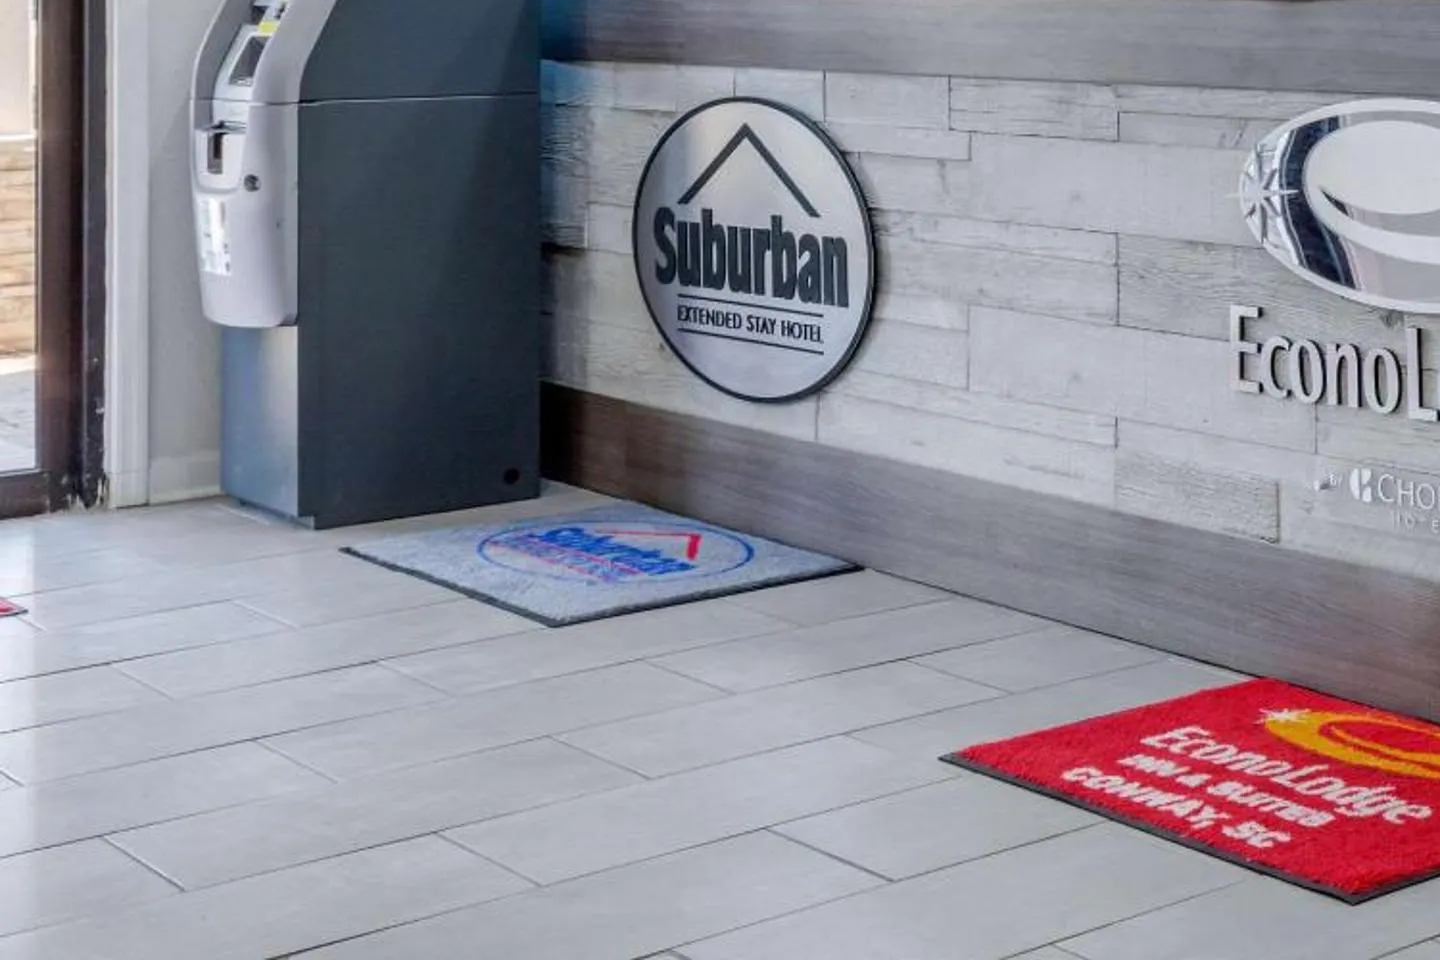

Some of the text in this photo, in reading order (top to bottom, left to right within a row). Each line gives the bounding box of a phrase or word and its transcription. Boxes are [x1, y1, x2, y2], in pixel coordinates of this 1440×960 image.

[653, 206, 850, 308] Suburban
[676, 304, 823, 344] EXTENDED STAY HOTEL
[1139, 725, 1433, 825] EconoLodge
[1221, 820, 1293, 849] SC
